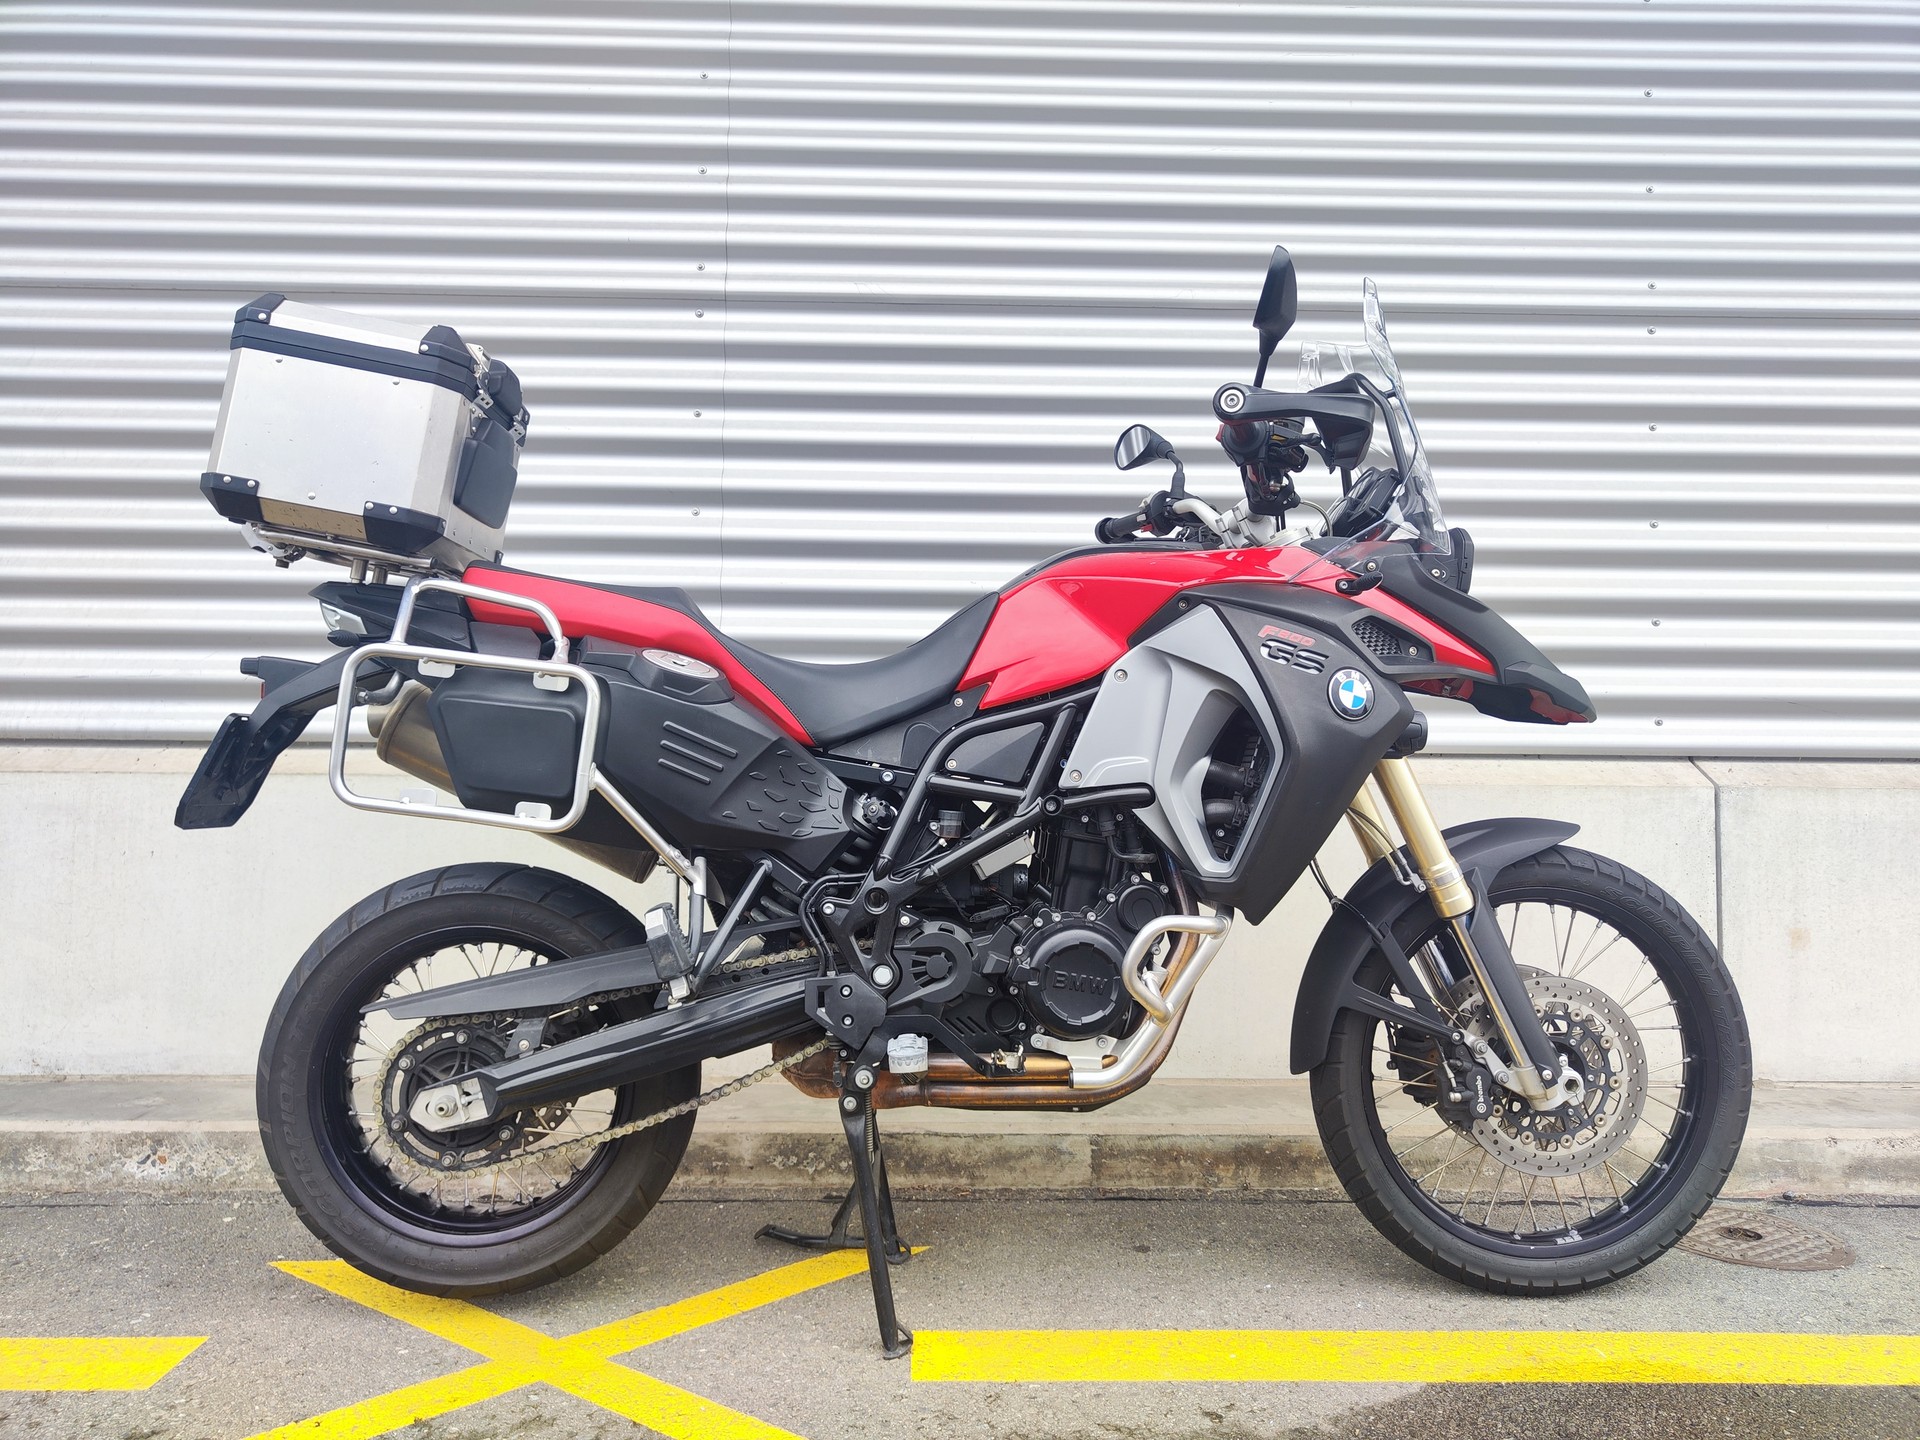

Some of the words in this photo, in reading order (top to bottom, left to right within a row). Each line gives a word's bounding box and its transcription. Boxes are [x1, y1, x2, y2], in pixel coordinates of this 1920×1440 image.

[1260, 638, 1329, 675] GS
[1336, 670, 1373, 691] BMW
[1053, 970, 1108, 995] BMW
[1475, 1075, 1484, 1103] brembo
